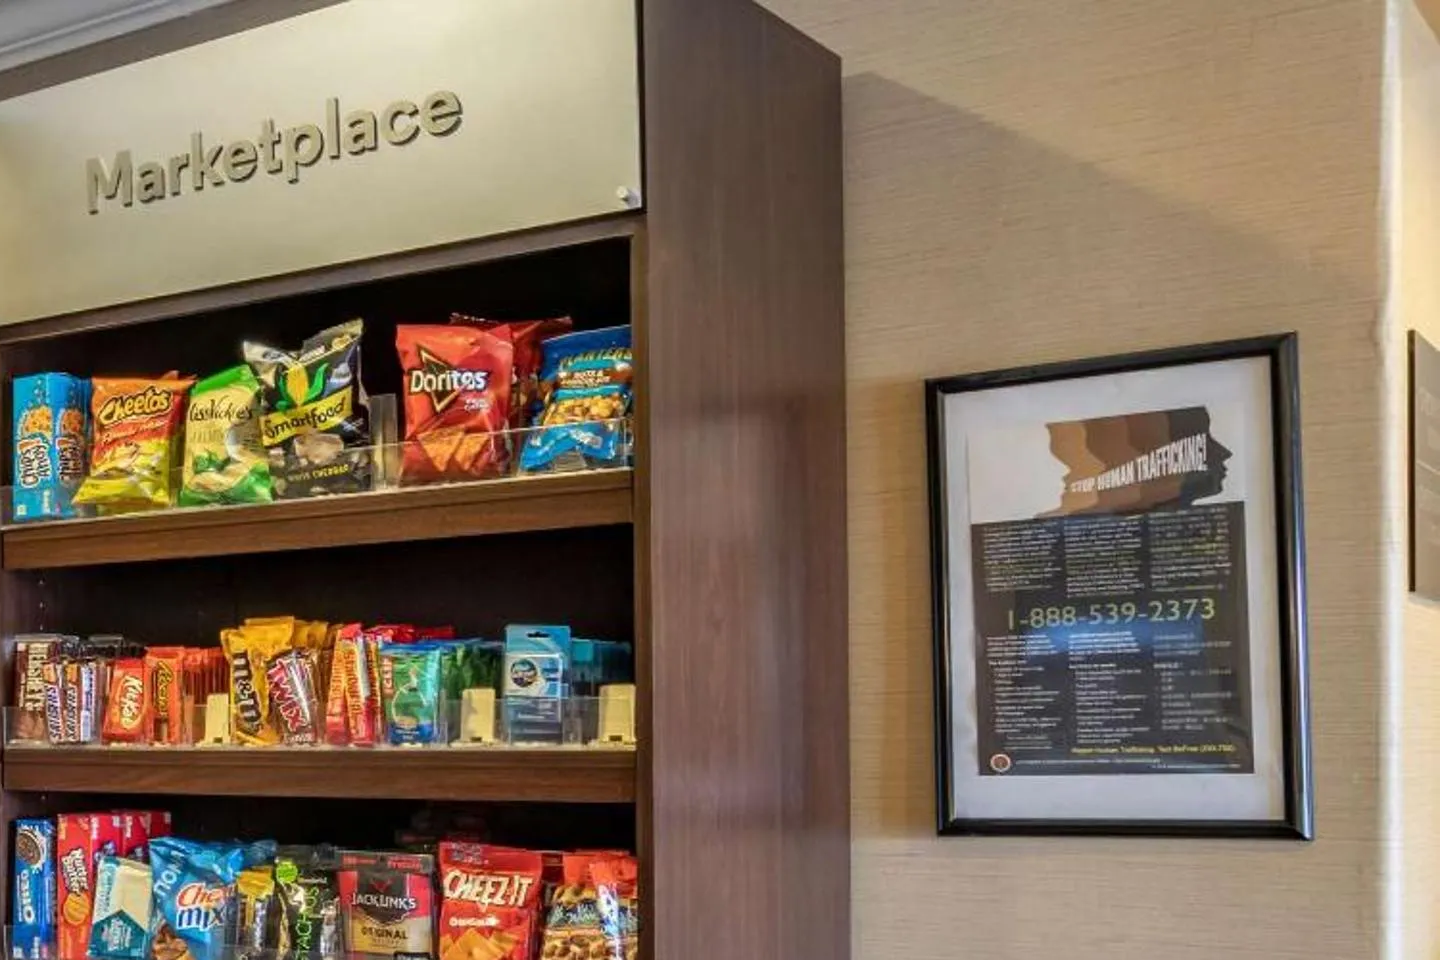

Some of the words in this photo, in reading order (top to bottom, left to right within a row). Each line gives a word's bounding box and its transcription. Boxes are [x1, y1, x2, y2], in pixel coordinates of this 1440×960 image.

[85, 89, 463, 215] Marketplace
[410, 368, 488, 393] Doritos
[99, 385, 174, 424] Cheetos
[263, 396, 347, 439] Smartfood
[1008, 599, 1216, 630] 1-888-539-2373
